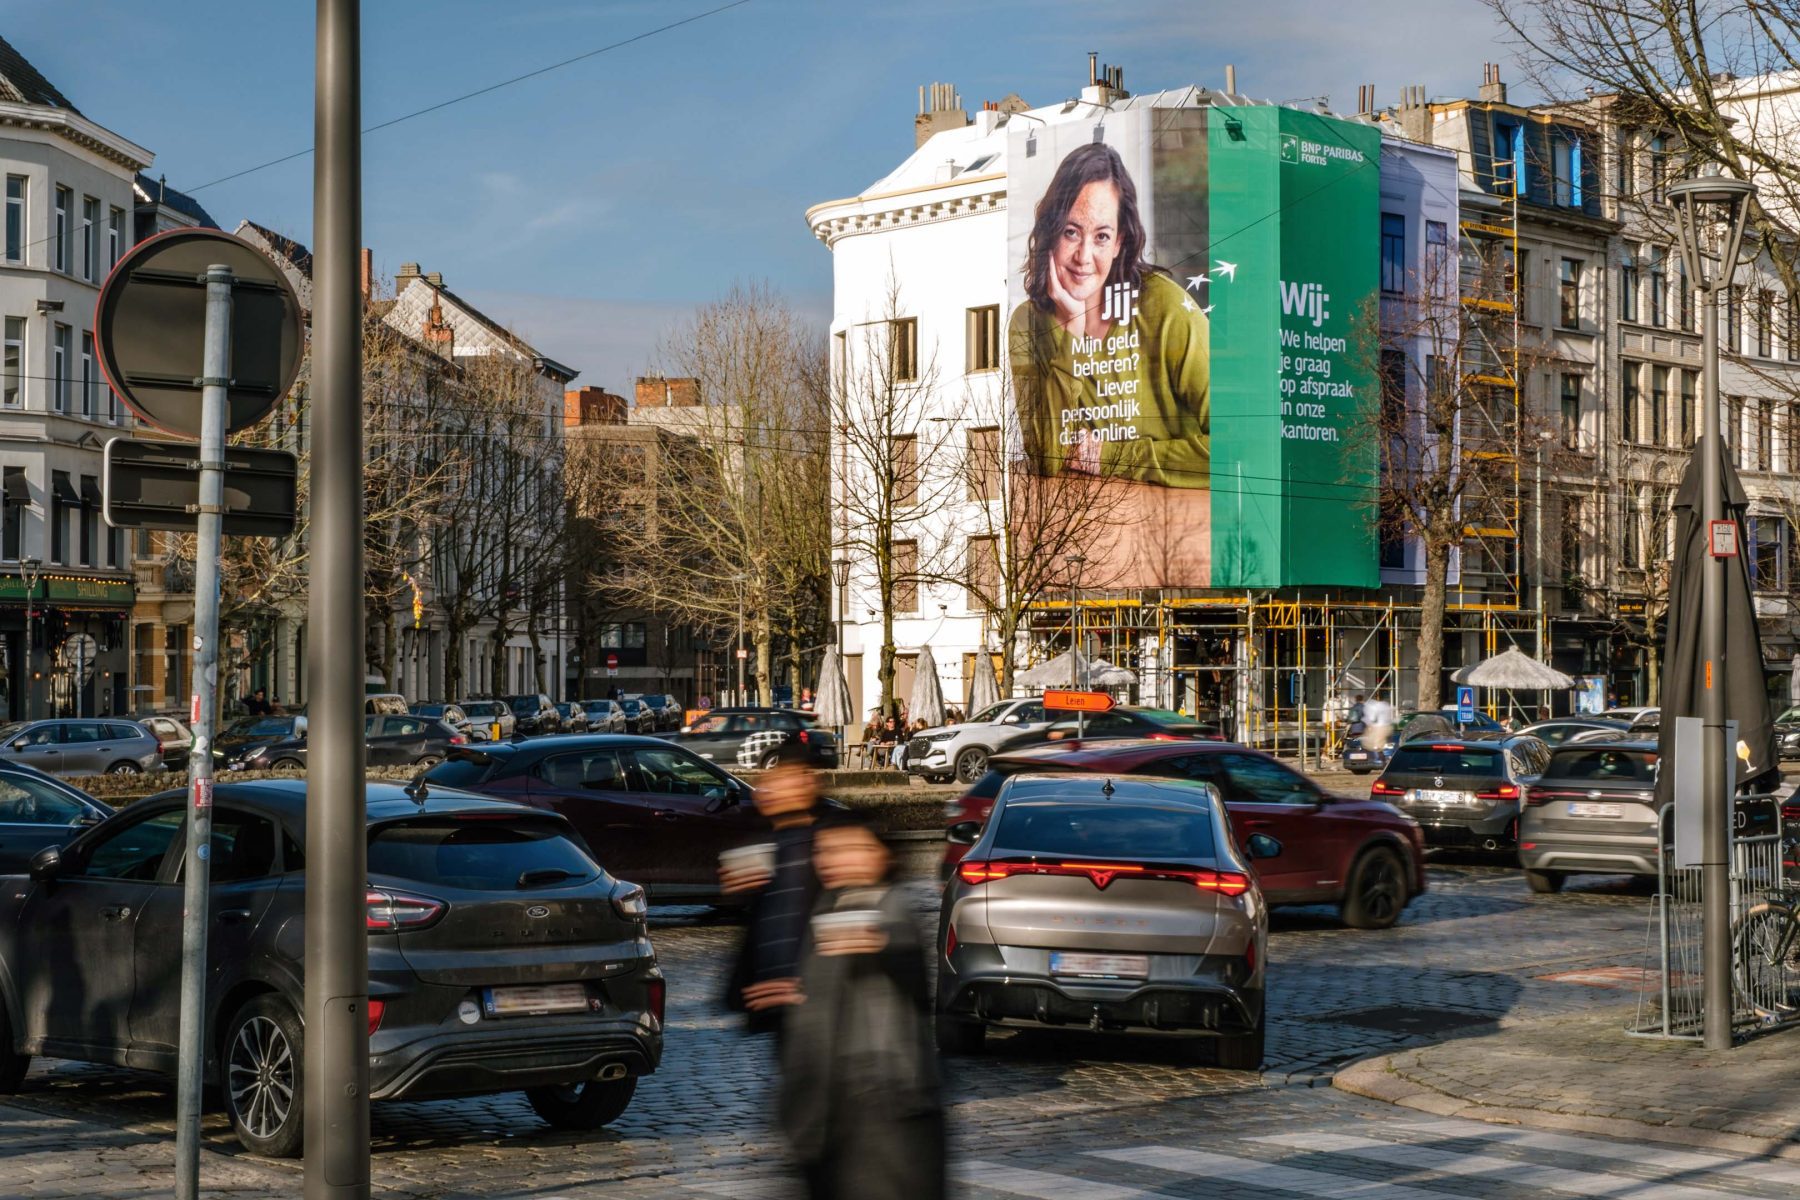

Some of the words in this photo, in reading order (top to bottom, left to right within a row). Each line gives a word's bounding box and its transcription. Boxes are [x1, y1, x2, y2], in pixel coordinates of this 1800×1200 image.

[1301, 141, 1321, 154] BNP
[1323, 145, 1364, 162] PARIBAS
[1301, 153, 1327, 166] FORTIS
[1101, 282, 1139, 326] Jij:
[1280, 280, 1330, 327] Wij:
[1071, 336, 1102, 358] Mijn
[1107, 329, 1140, 356] geld
[1279, 328, 1300, 348] We
[1304, 331, 1346, 356] helpen
[1073, 353, 1140, 377] beheren?
[1278, 352, 1291, 374] je
[1295, 357, 1331, 378] graag
[1096, 379, 1140, 397] Liever
[1280, 378, 1296, 398] op
[1300, 376, 1354, 400] afspraak
[1061, 398, 1141, 428] persoonlijk
[1280, 397, 1292, 415] in
[1296, 403, 1326, 418] onze
[1091, 423, 1140, 443] online.
[1281, 420, 1340, 442] kantoren.
[77, 583, 108, 597] SHILLING
[1066, 695, 1085, 706] Leien
